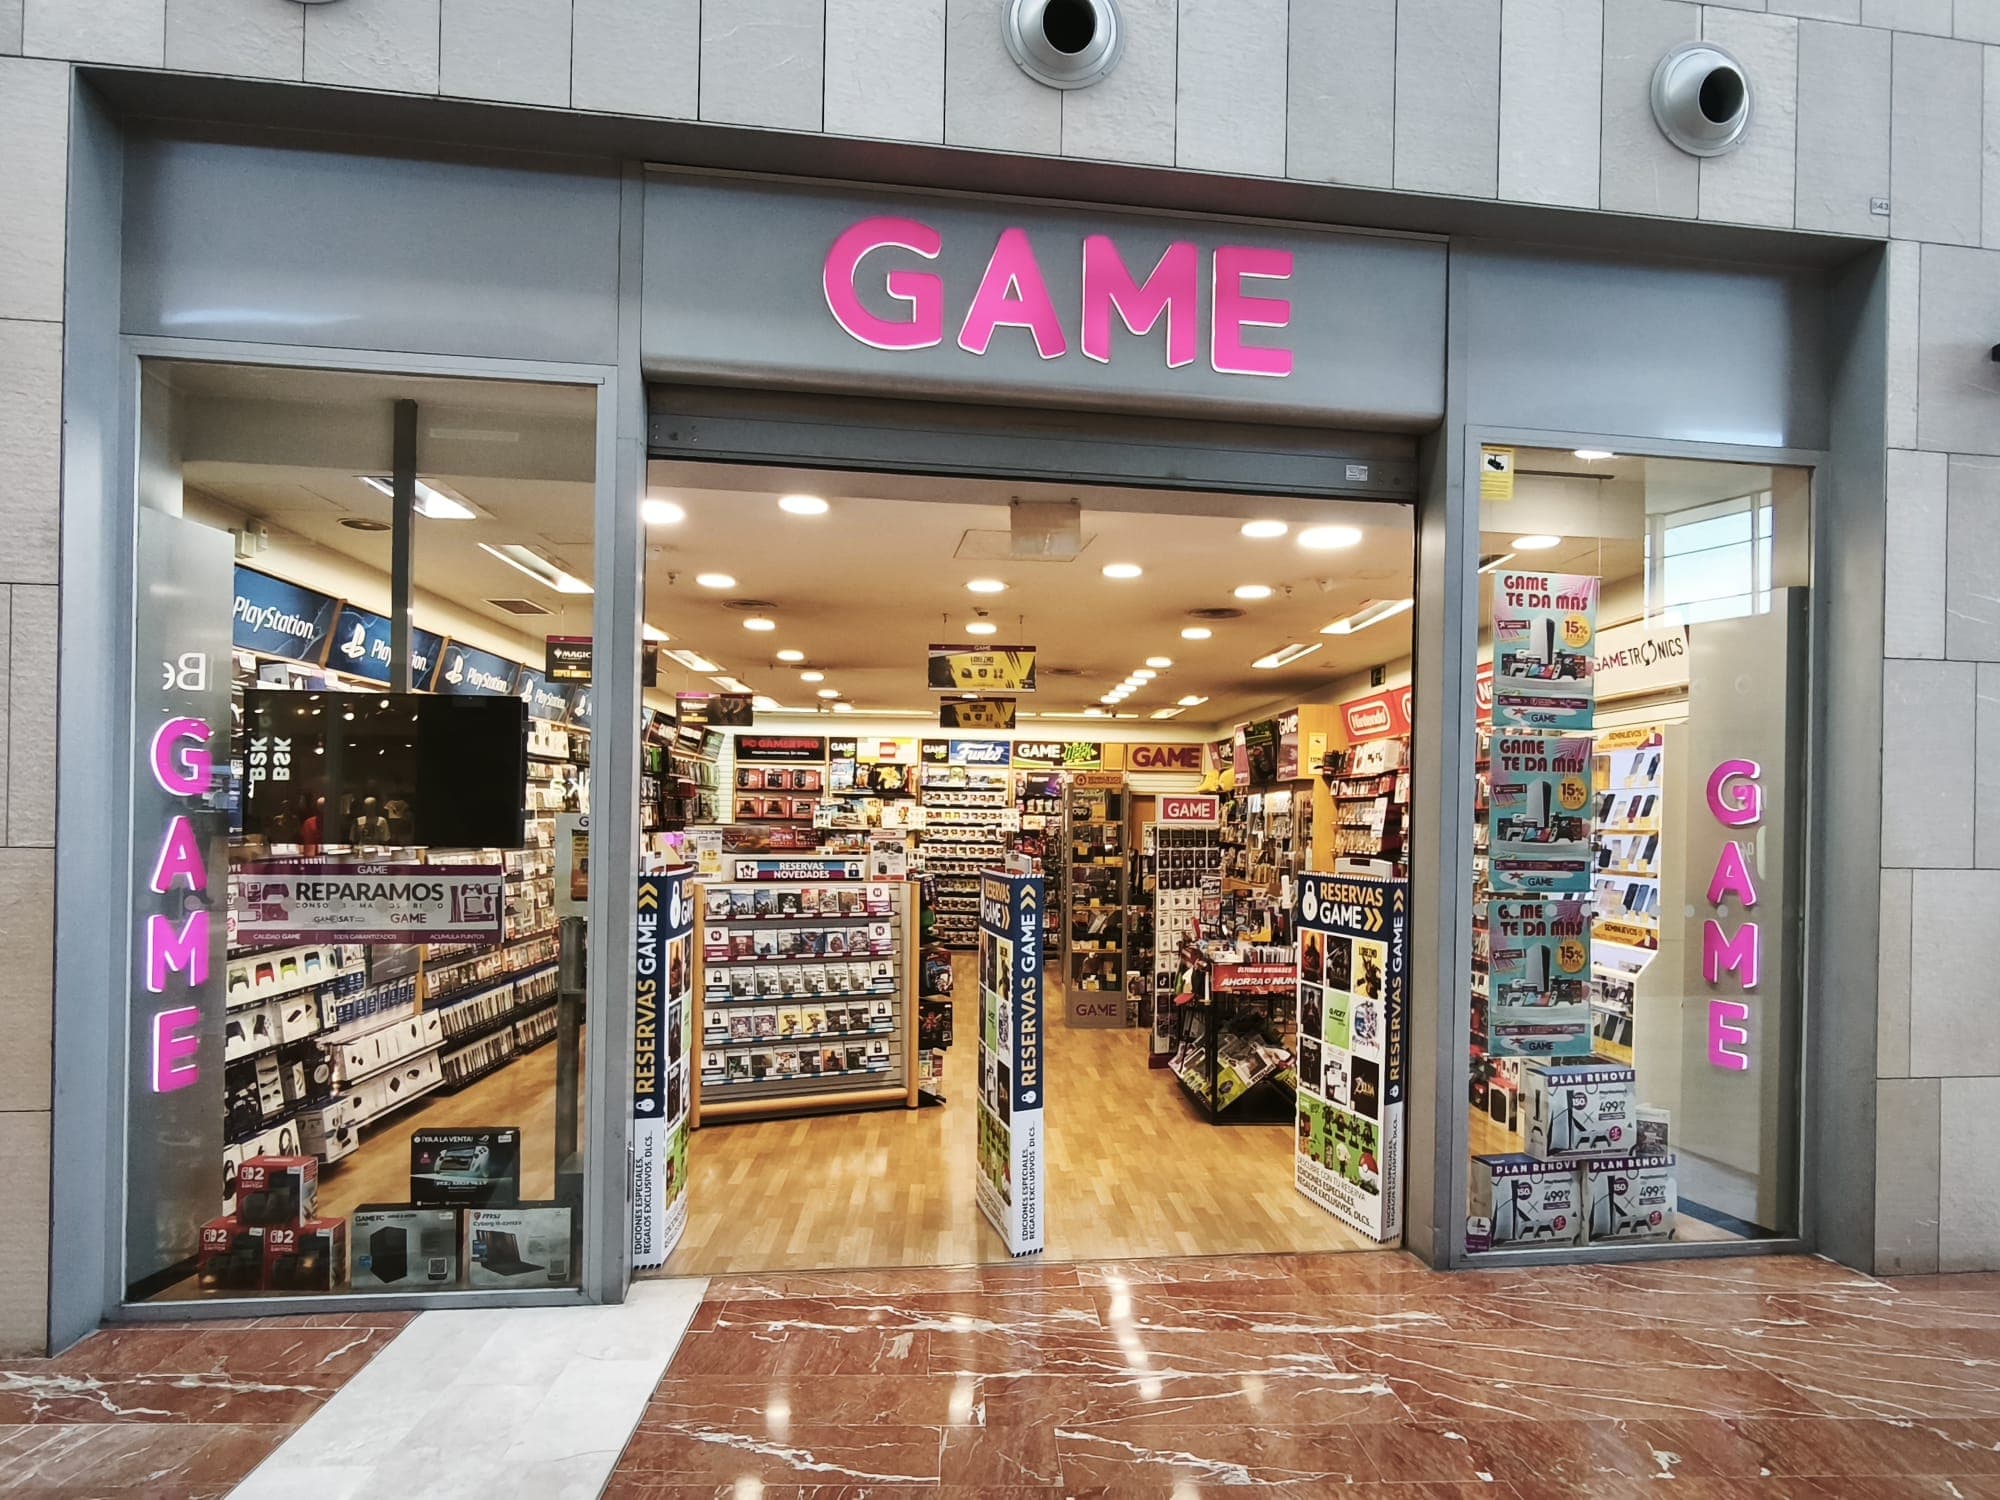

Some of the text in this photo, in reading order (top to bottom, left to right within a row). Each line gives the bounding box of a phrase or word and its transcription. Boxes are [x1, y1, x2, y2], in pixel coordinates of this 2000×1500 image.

[823, 216, 1292, 376] GAME
[1504, 576, 1548, 591] GAME
[1506, 593, 1523, 607] TE
[1529, 594, 1550, 608] DA
[233, 596, 314, 640] PlayStation
[1565, 621, 1587, 634] 15%
[562, 650, 592, 658] MAGIC
[1531, 714, 1556, 722] GAME
[831, 743, 856, 752] GAME
[923, 745, 948, 753] GAME
[956, 743, 1004, 761] Funko
[1018, 744, 1061, 758] GAME
[1500, 740, 1544, 754] GAME
[1133, 747, 1200, 768] GAME
[1502, 756, 1519, 771] TE
[1525, 758, 1547, 772] DA
[1561, 783, 1584, 796] 15%
[1168, 803, 1210, 817] GAME
[358, 866, 388, 874] GAME
[779, 862, 824, 870] RESERVAS
[773, 870, 830, 879] NOVEDADES
[1528, 878, 1554, 886] GAME
[296, 882, 444, 901] REPARAMOS
[985, 879, 1010, 904] RESERVAS
[1320, 882, 1383, 910] RESERVAS
[147, 716, 214, 1092] GAME
[390, 914, 426, 923] GAME
[984, 899, 1000, 927] GAME
[1320, 903, 1362, 930] GAME
[1498, 904, 1542, 920] GME
[1703, 758, 1761, 1070] GAME
[1500, 922, 1518, 936] TE
[1524, 922, 1546, 936] DA
[1560, 946, 1583, 959] 15%
[1221, 978, 1264, 986] AHORRA
[1272, 978, 1298, 986] NUN
[636, 913, 657, 1094] RESERVAS GAME
[1021, 914, 1036, 1086] RESERVAS GAME
[1390, 916, 1404, 1081] RESERVAS GAME
[1076, 1004, 1117, 1016] GAME
[1529, 1042, 1554, 1050] GAME
[1552, 1071, 1632, 1084] PLAN RENOVE
[1496, 1161, 1577, 1174] PLAN RENOVE
[1593, 1160, 1622, 1170] PLAN
[254, 1168, 264, 1180] 2
[218, 1230, 227, 1242] 2
[284, 1230, 294, 1244] 2
[634, 1209, 642, 1255] EDICIONES
